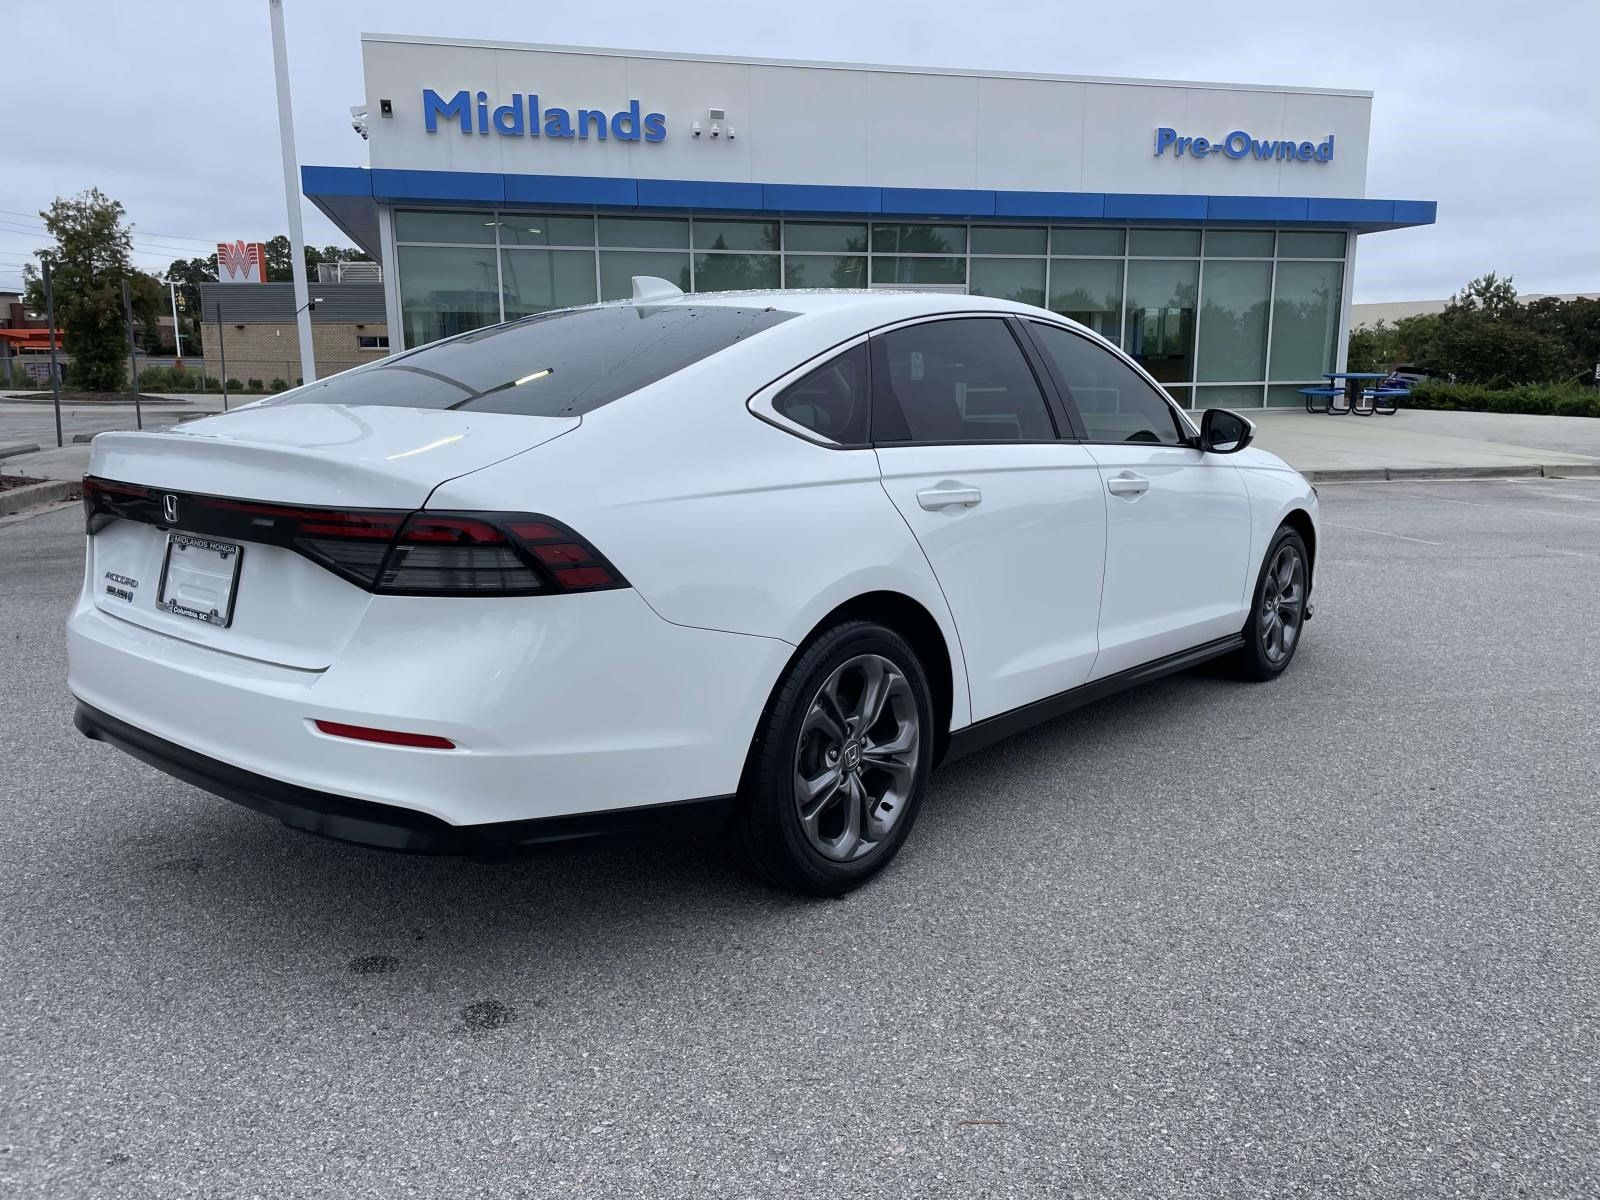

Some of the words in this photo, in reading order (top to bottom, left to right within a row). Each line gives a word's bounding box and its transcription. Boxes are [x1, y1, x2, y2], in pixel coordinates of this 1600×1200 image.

[422, 88, 667, 142] Midlands
[1154, 127, 1335, 162] Pre-Owned
[174, 535, 208, 548] MIDLANDS
[209, 543, 235, 553] HONDA
[198, 613, 208, 621] SC
